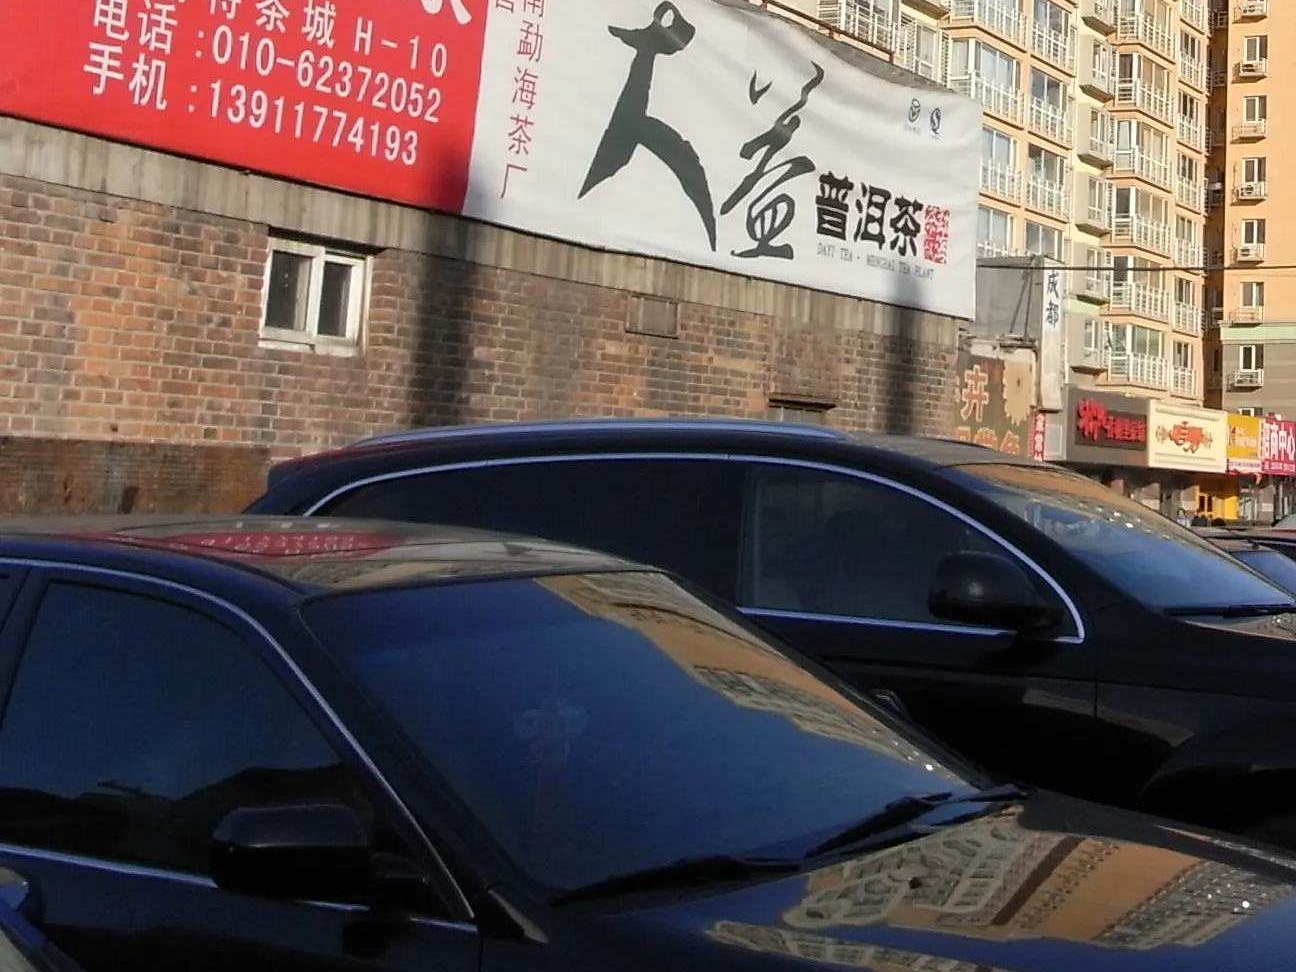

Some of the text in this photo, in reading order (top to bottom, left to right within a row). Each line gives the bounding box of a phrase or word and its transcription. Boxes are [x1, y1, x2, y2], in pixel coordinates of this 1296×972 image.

[353, 17, 448, 79] H-10
[815, 170, 924, 257] 普洱茶
[840, 247, 853, 262] TEA
[898, 262, 912, 276] TEA
[1045, 270, 1060, 328] 成都
